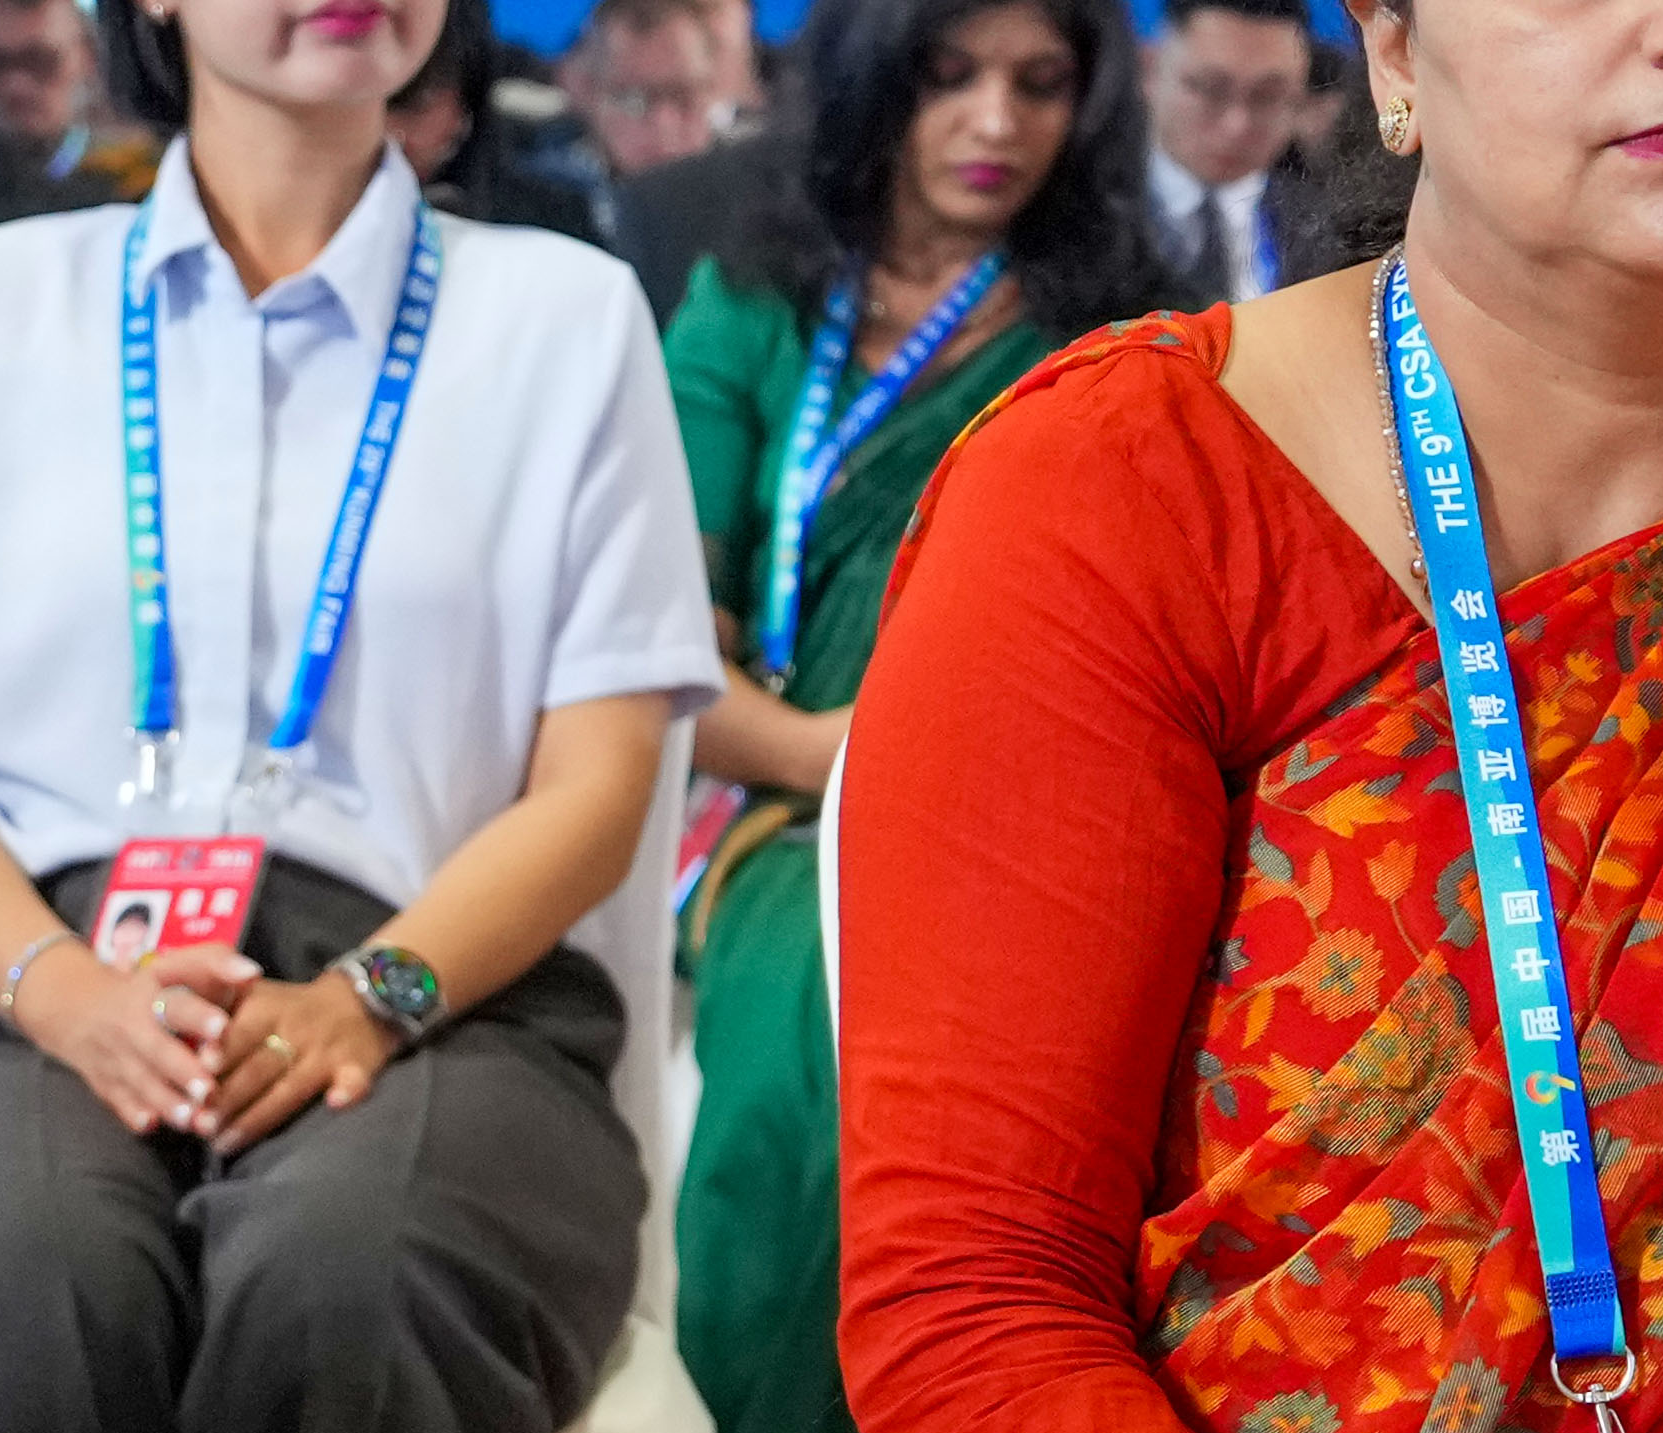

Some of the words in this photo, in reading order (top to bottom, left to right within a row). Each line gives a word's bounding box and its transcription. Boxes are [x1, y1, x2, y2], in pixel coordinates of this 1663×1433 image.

[1396, 323, 1437, 400] CSA
[1410, 409, 1453, 456] 9TH
[1425, 463, 1469, 534] THE
[1451, 587, 1581, 1166] 第9届中国-南亚博览会
